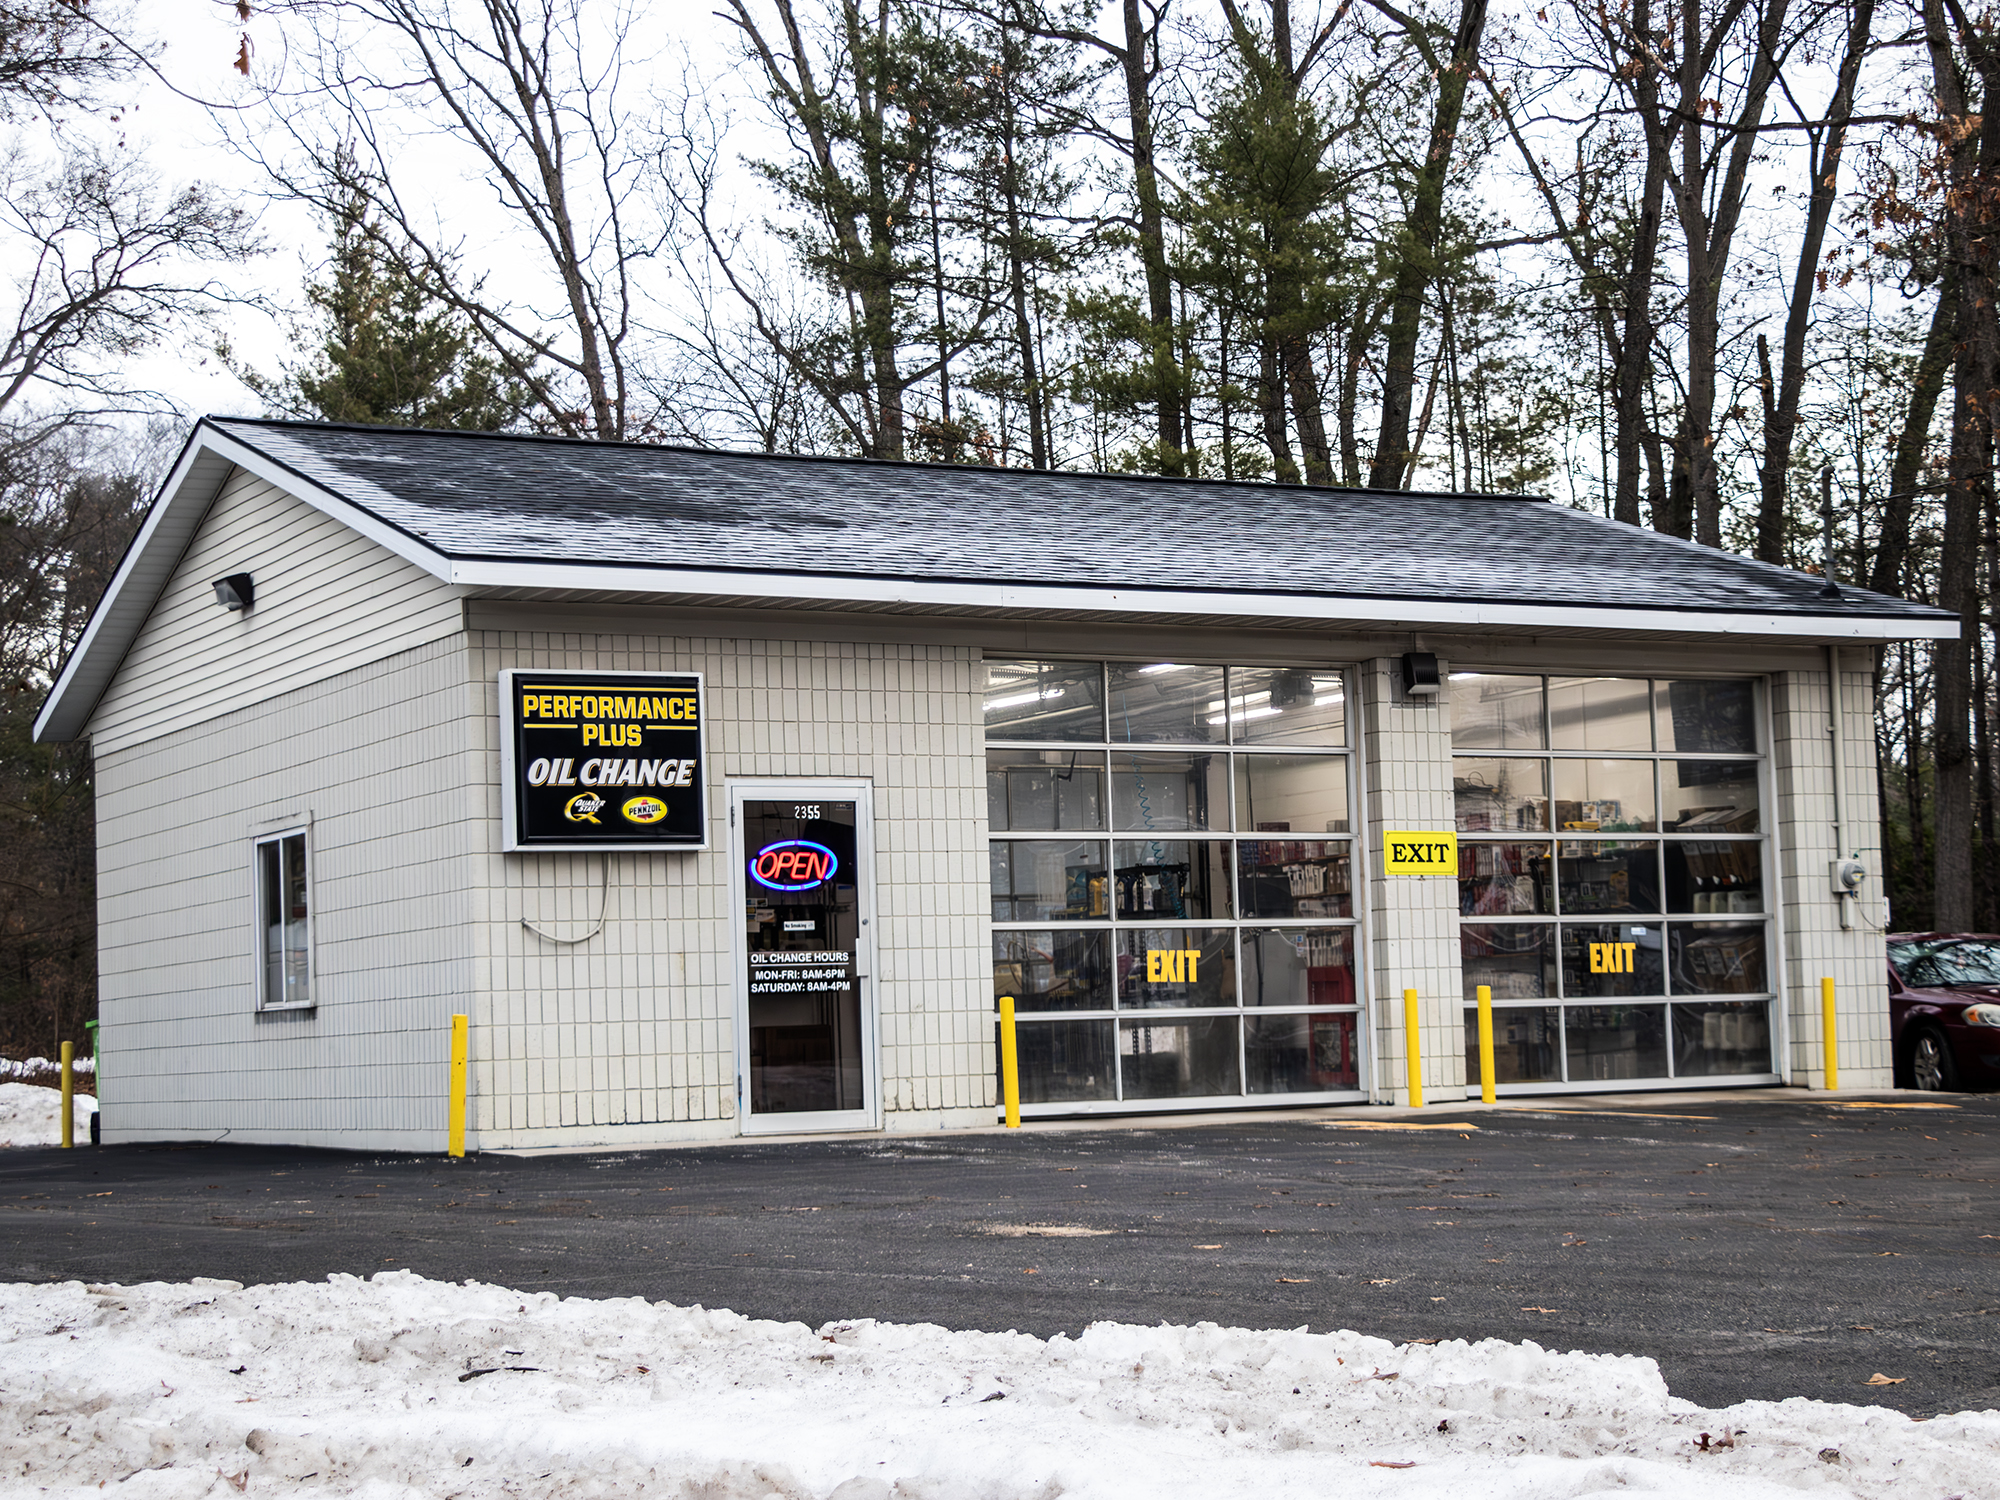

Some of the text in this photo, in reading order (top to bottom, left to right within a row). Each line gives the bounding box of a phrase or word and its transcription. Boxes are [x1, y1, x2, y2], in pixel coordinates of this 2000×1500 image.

[523, 695, 697, 719] PERFORMANCE
[583, 723, 642, 746] PLUS
[528, 758, 697, 787] OIL CHANGE
[574, 799, 606, 807] QUAKER
[628, 804, 662, 816] PENNZOIL
[794, 805, 821, 819] 2355
[1391, 843, 1450, 864] EXIT
[756, 851, 830, 880] OPEN
[751, 952, 849, 964] OIL CHANGE HOURS
[1146, 949, 1201, 983] EXIT
[1589, 942, 1636, 974] EXIT
[755, 969, 846, 980] MON-FRI: 8AM-6PM
[751, 981, 850, 993] SATURDAY: 8AM-4PM
